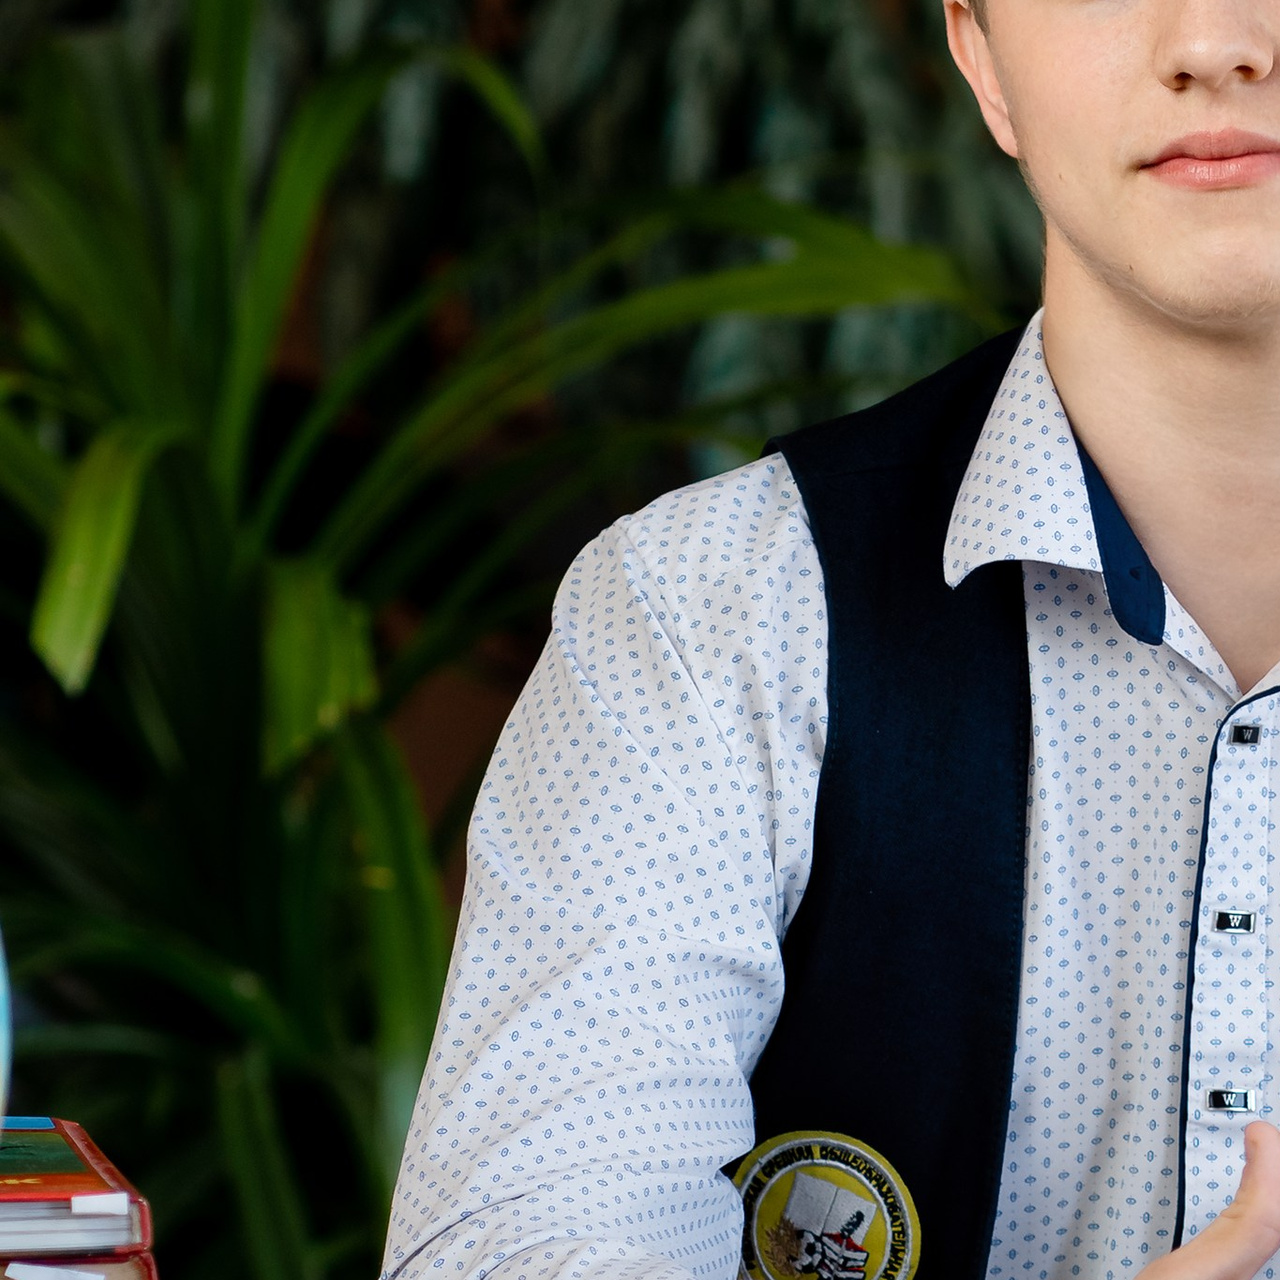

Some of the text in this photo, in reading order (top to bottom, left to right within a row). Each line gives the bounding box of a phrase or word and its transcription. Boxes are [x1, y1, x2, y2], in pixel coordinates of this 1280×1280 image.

[1242, 729, 1253, 740] W
[1229, 915, 1242, 927] W
[1222, 1093, 1236, 1106] W
[762, 1145, 814, 1179] СРЕДНЯЯ
